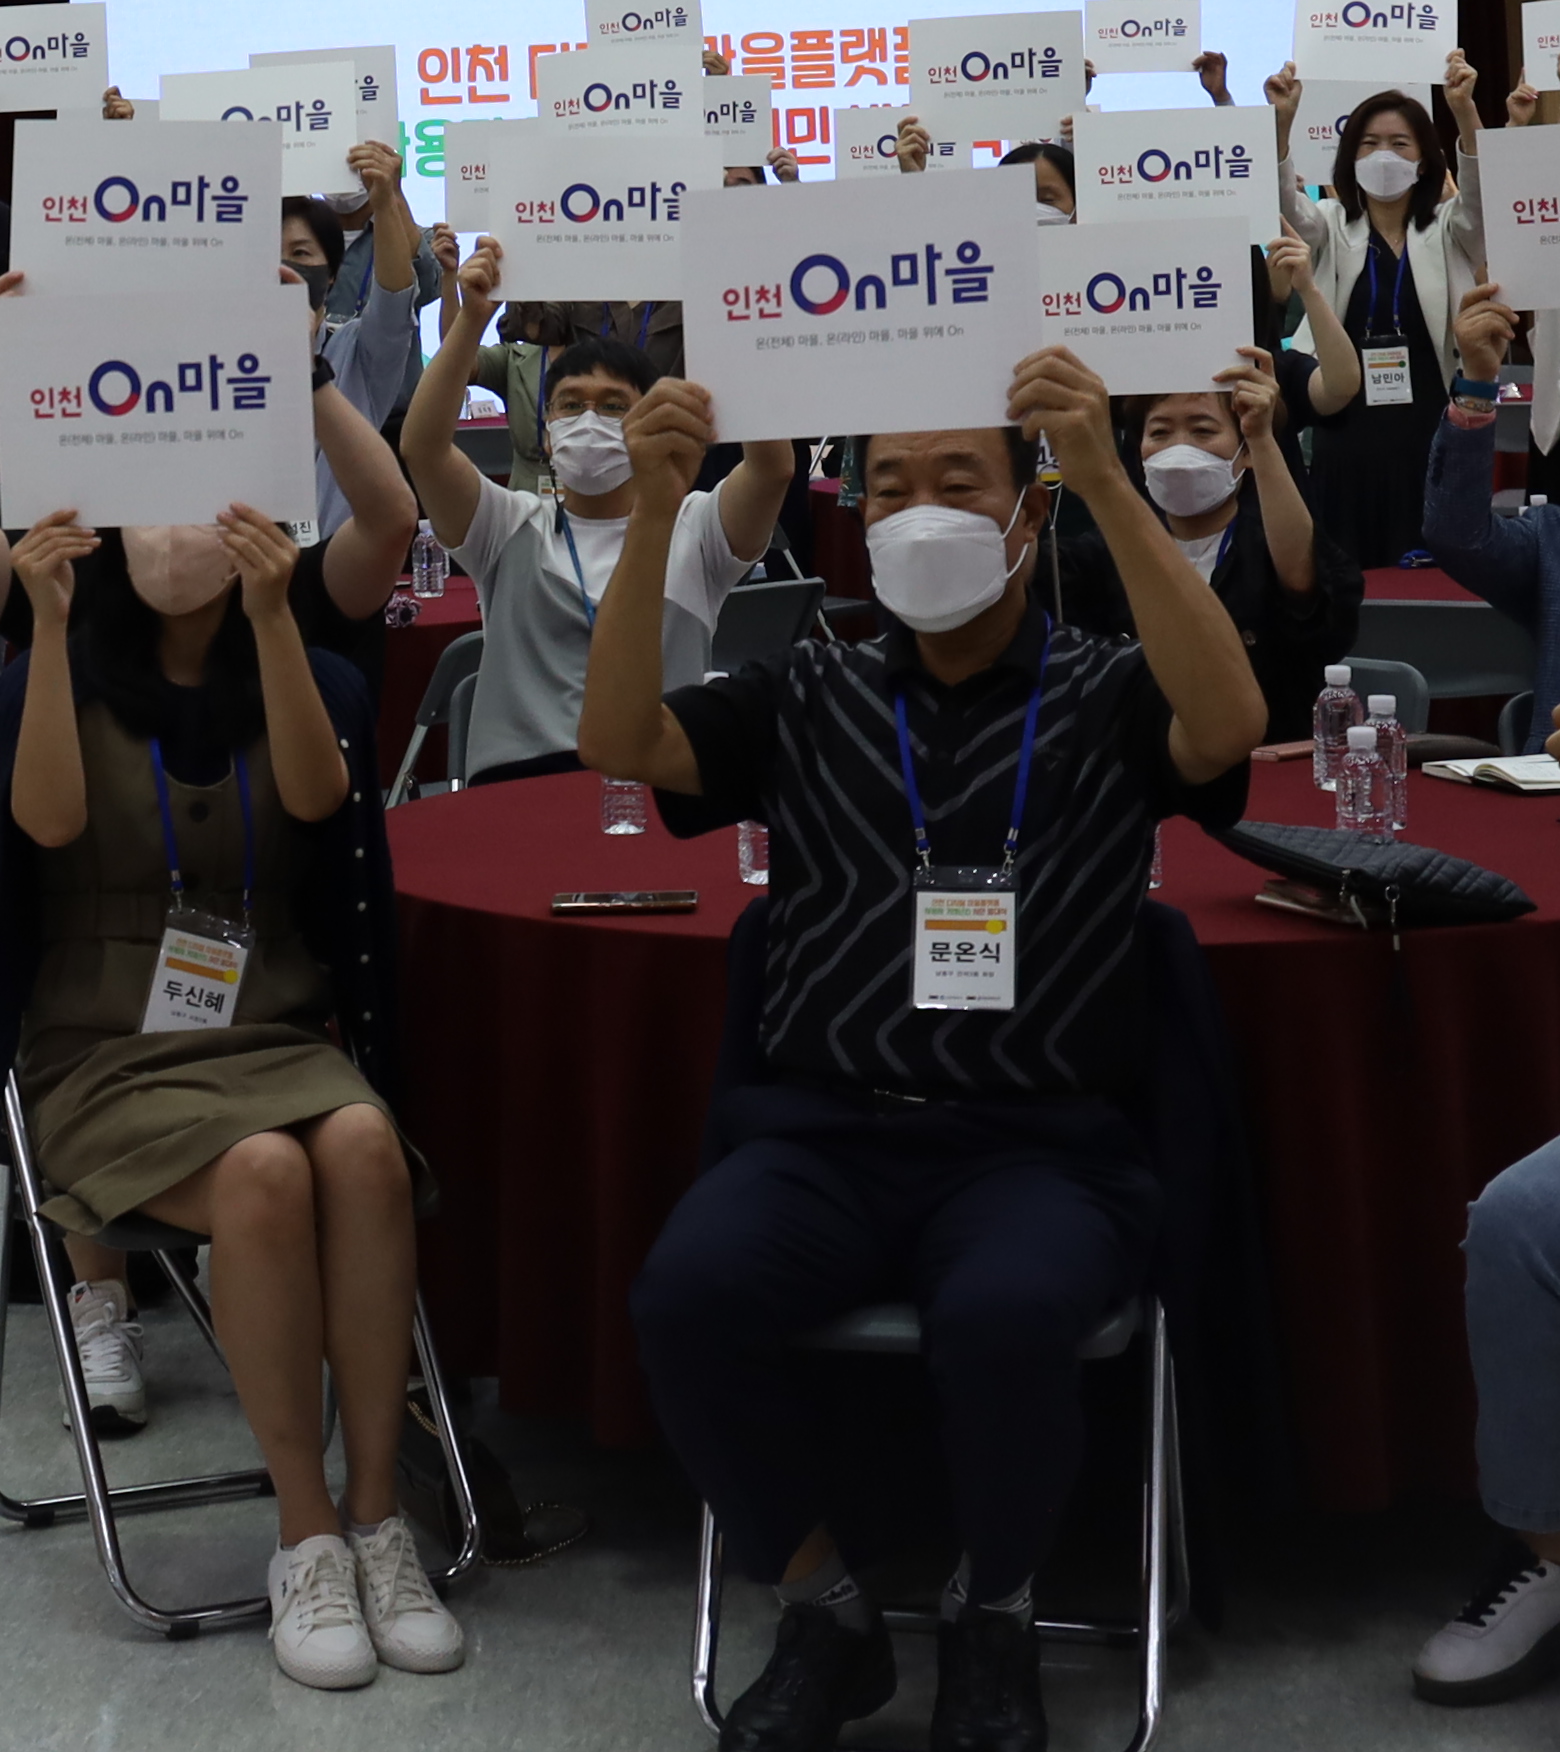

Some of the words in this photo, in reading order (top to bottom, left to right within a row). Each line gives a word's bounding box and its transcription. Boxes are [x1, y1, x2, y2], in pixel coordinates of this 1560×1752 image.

[417, 44, 510, 106] 인천
[42, 196, 88, 223] 인천
[515, 200, 555, 224] 인천
[1512, 197, 1559, 225] 인천
[722, 283, 783, 322] 인천
[1041, 291, 1082, 317] 인천
[30, 385, 82, 419] 인천
[929, 941, 1001, 964] 문온식
[163, 980, 225, 1014] 두신혜
